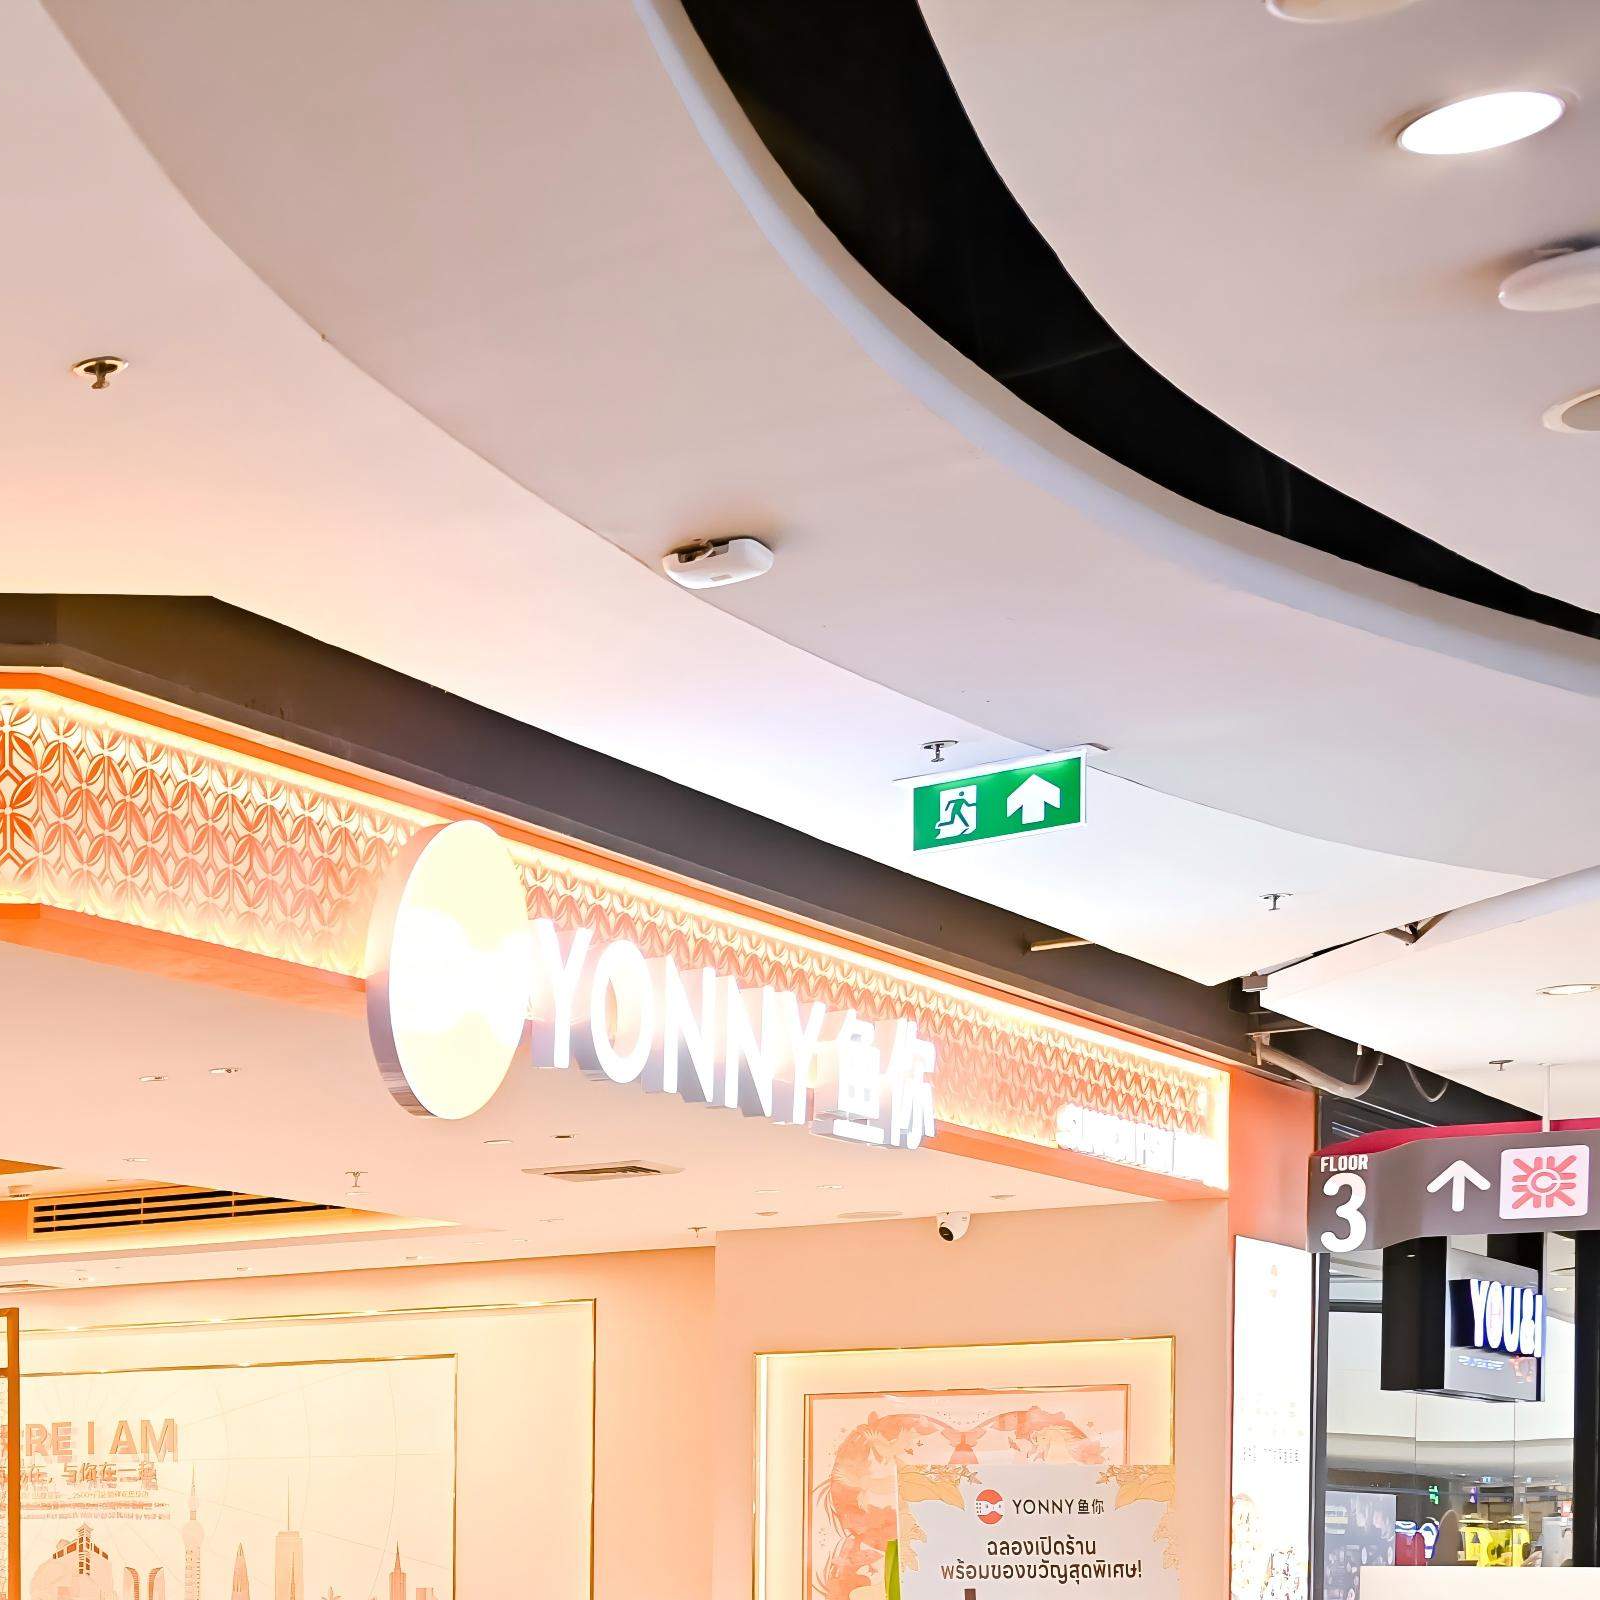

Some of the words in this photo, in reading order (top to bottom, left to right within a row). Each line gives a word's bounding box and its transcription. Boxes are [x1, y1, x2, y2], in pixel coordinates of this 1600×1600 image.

[1320, 1154, 1368, 1172] FLOOR
[1320, 1172, 1367, 1253] 3
[87, 1421, 95, 1455] I
[109, 1418, 179, 1462] AM
[987, 1534, 1097, 1557] ฉลองเปิดร้าน
[941, 1558, 1143, 1585] พร้อมของขวัญสุดพิเศษ!
